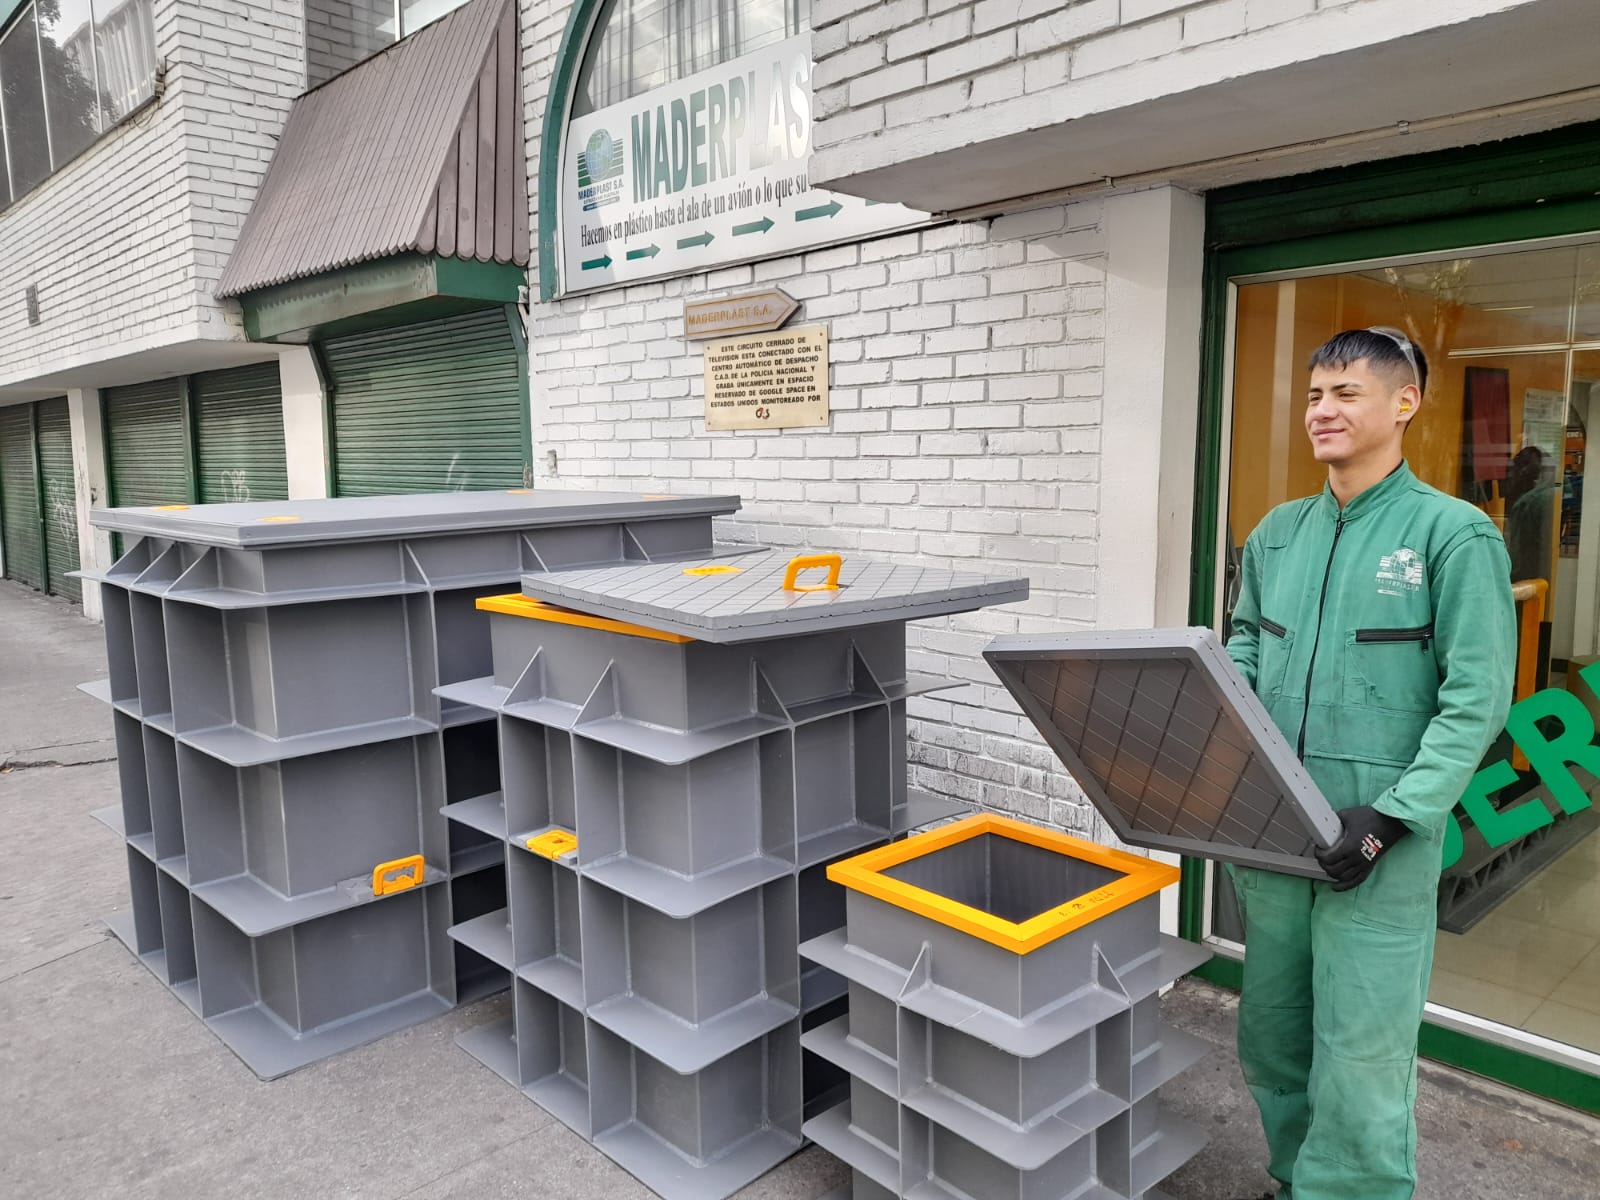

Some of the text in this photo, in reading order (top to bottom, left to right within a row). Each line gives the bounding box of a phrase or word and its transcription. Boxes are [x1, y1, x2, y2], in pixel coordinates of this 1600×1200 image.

[581, 173, 807, 247] Hacemos en plástico hasta el ala de un avión o lo que su
[737, 341, 763, 351] CIRCUITO
[766, 338, 795, 347] CERRADO
[708, 354, 739, 363] TELEVISION
[741, 352, 755, 360] ESTA
[758, 348, 795, 358] CONECTADO
[797, 346, 811, 354] CON
[711, 364, 732, 372] CENTRO
[785, 355, 819, 365] DESPACHO
[741, 371, 748, 379] LA
[750, 370, 773, 378] POLICIA
[776, 367, 807, 375] NACIONAL
[715, 382, 734, 390] GRABA
[787, 376, 814, 384] ESPACIO
[714, 390, 746, 399] RESERVADO
[759, 388, 783, 396] GOOGLE
[786, 386, 805, 394] SPACE
[710, 394, 821, 408] ESTADOS UNIDOS MONITOREADO POR
